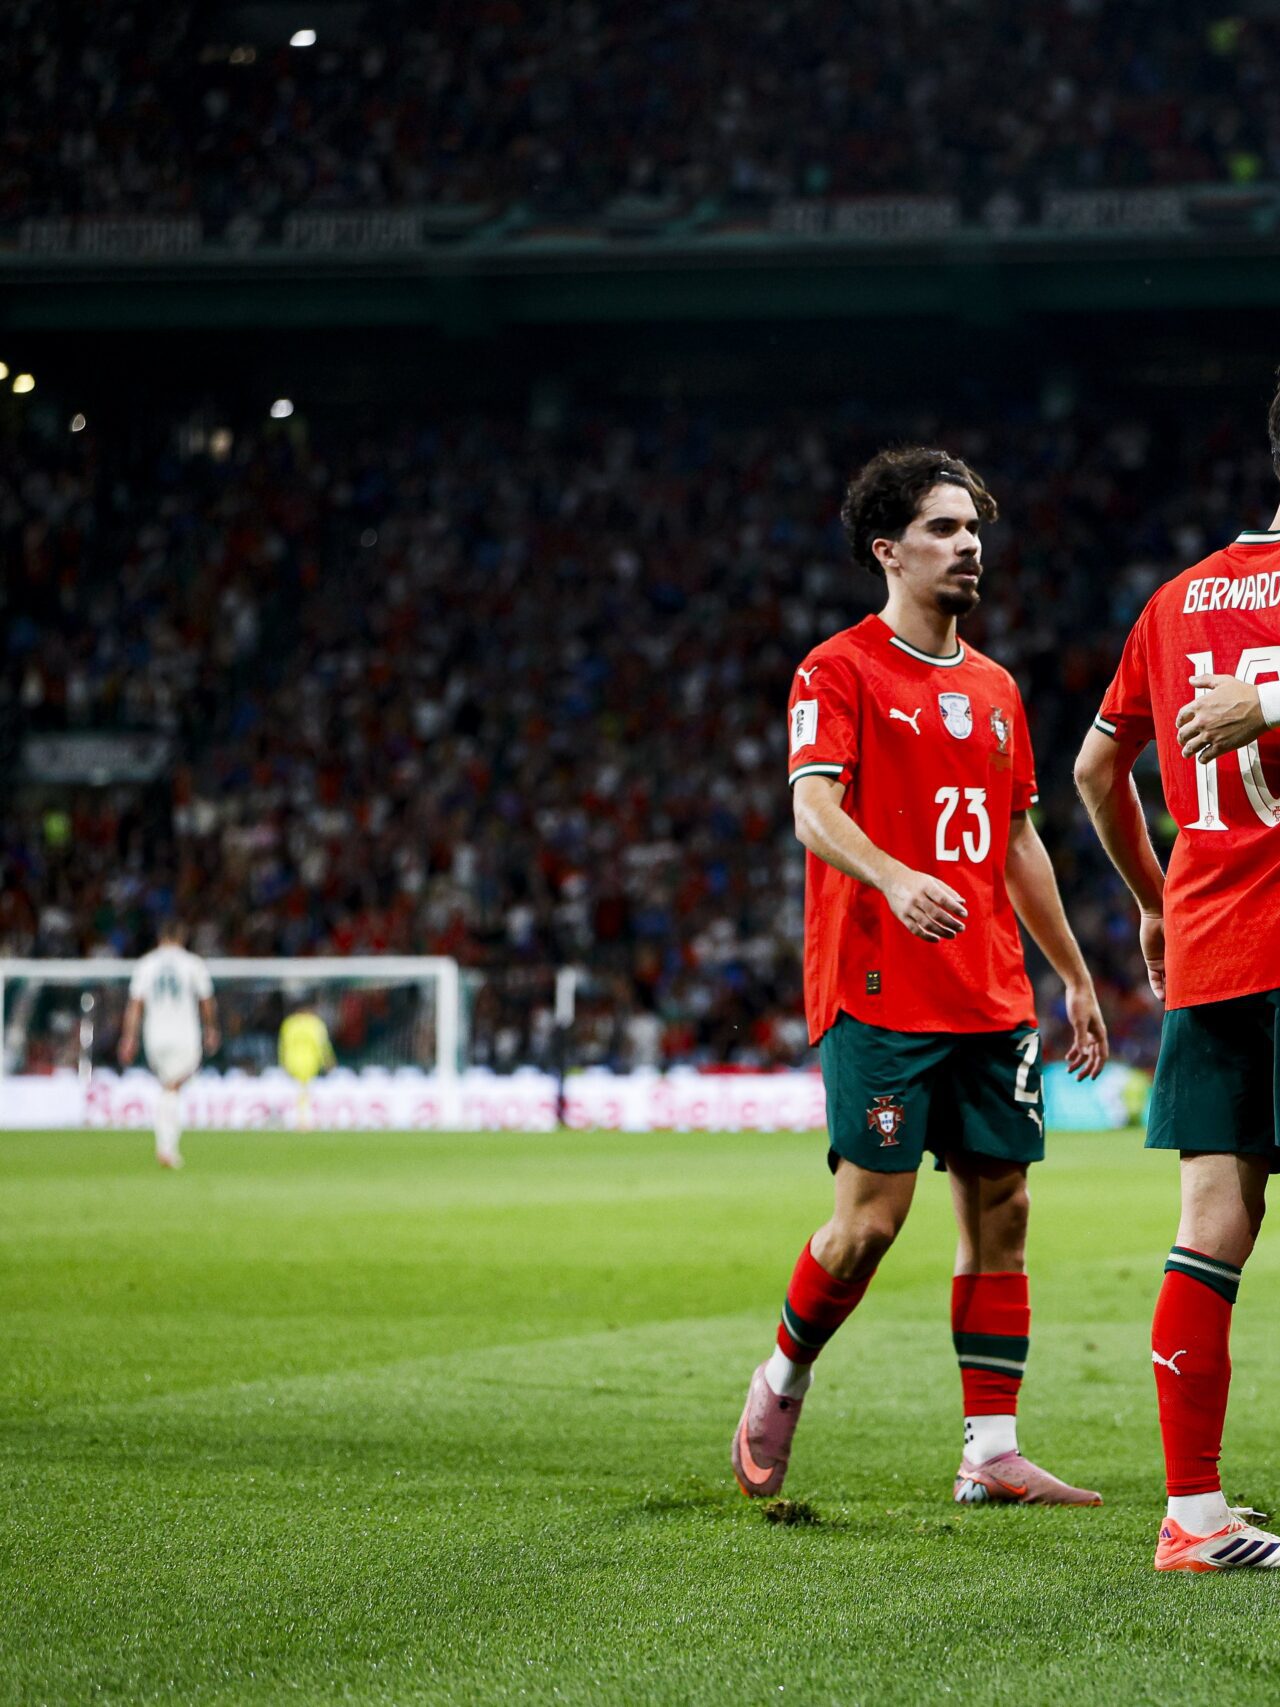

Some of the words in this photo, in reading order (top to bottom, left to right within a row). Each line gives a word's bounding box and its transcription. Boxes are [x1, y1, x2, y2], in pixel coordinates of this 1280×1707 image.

[934, 786, 991, 864] 23
[84, 1079, 391, 1128] Seuramos
[1014, 1031, 1044, 1104] 2
